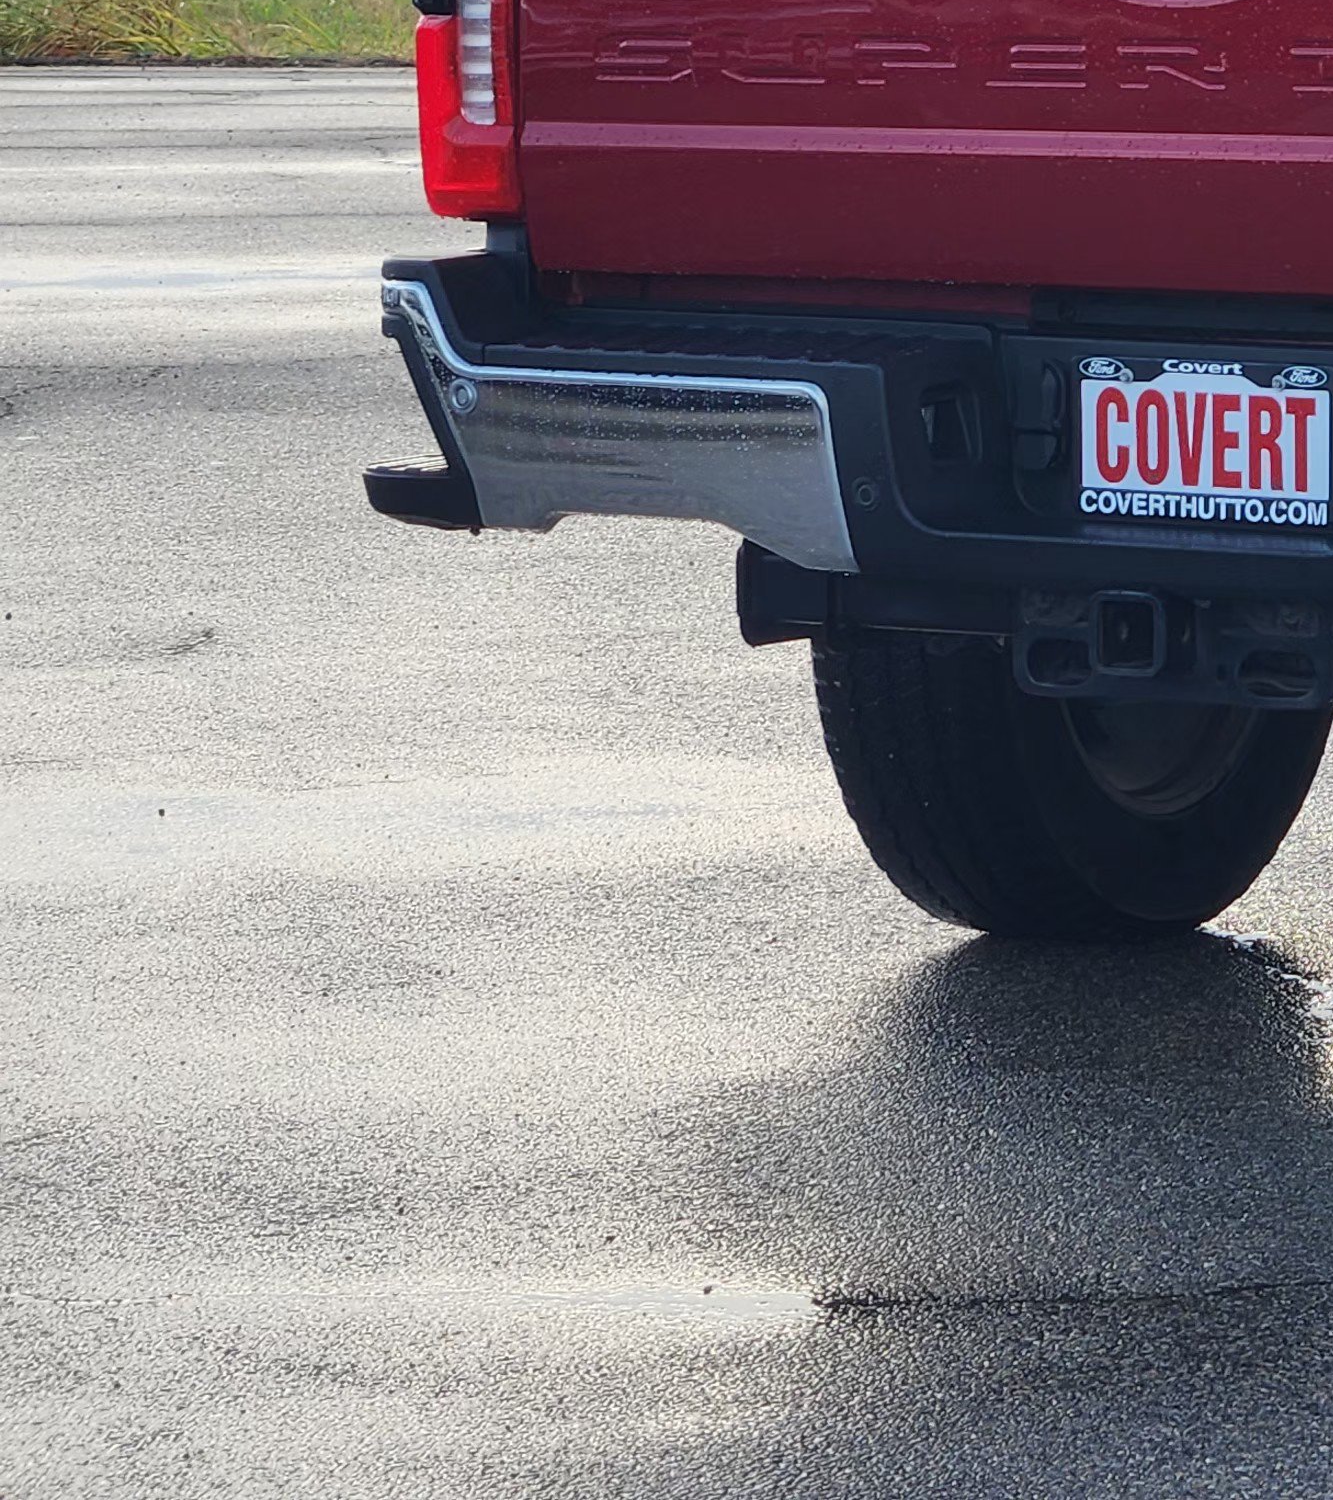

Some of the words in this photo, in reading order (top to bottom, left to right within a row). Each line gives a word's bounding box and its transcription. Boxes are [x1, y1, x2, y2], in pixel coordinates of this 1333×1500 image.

[594, 32, 1228, 92] SUPER
[1087, 358, 1117, 377] Ford
[1162, 359, 1244, 375] Covert
[1288, 367, 1318, 385] Ford
[1095, 387, 1317, 493] COVERT
[1080, 490, 1329, 527] COVERTHUTTO.COM
